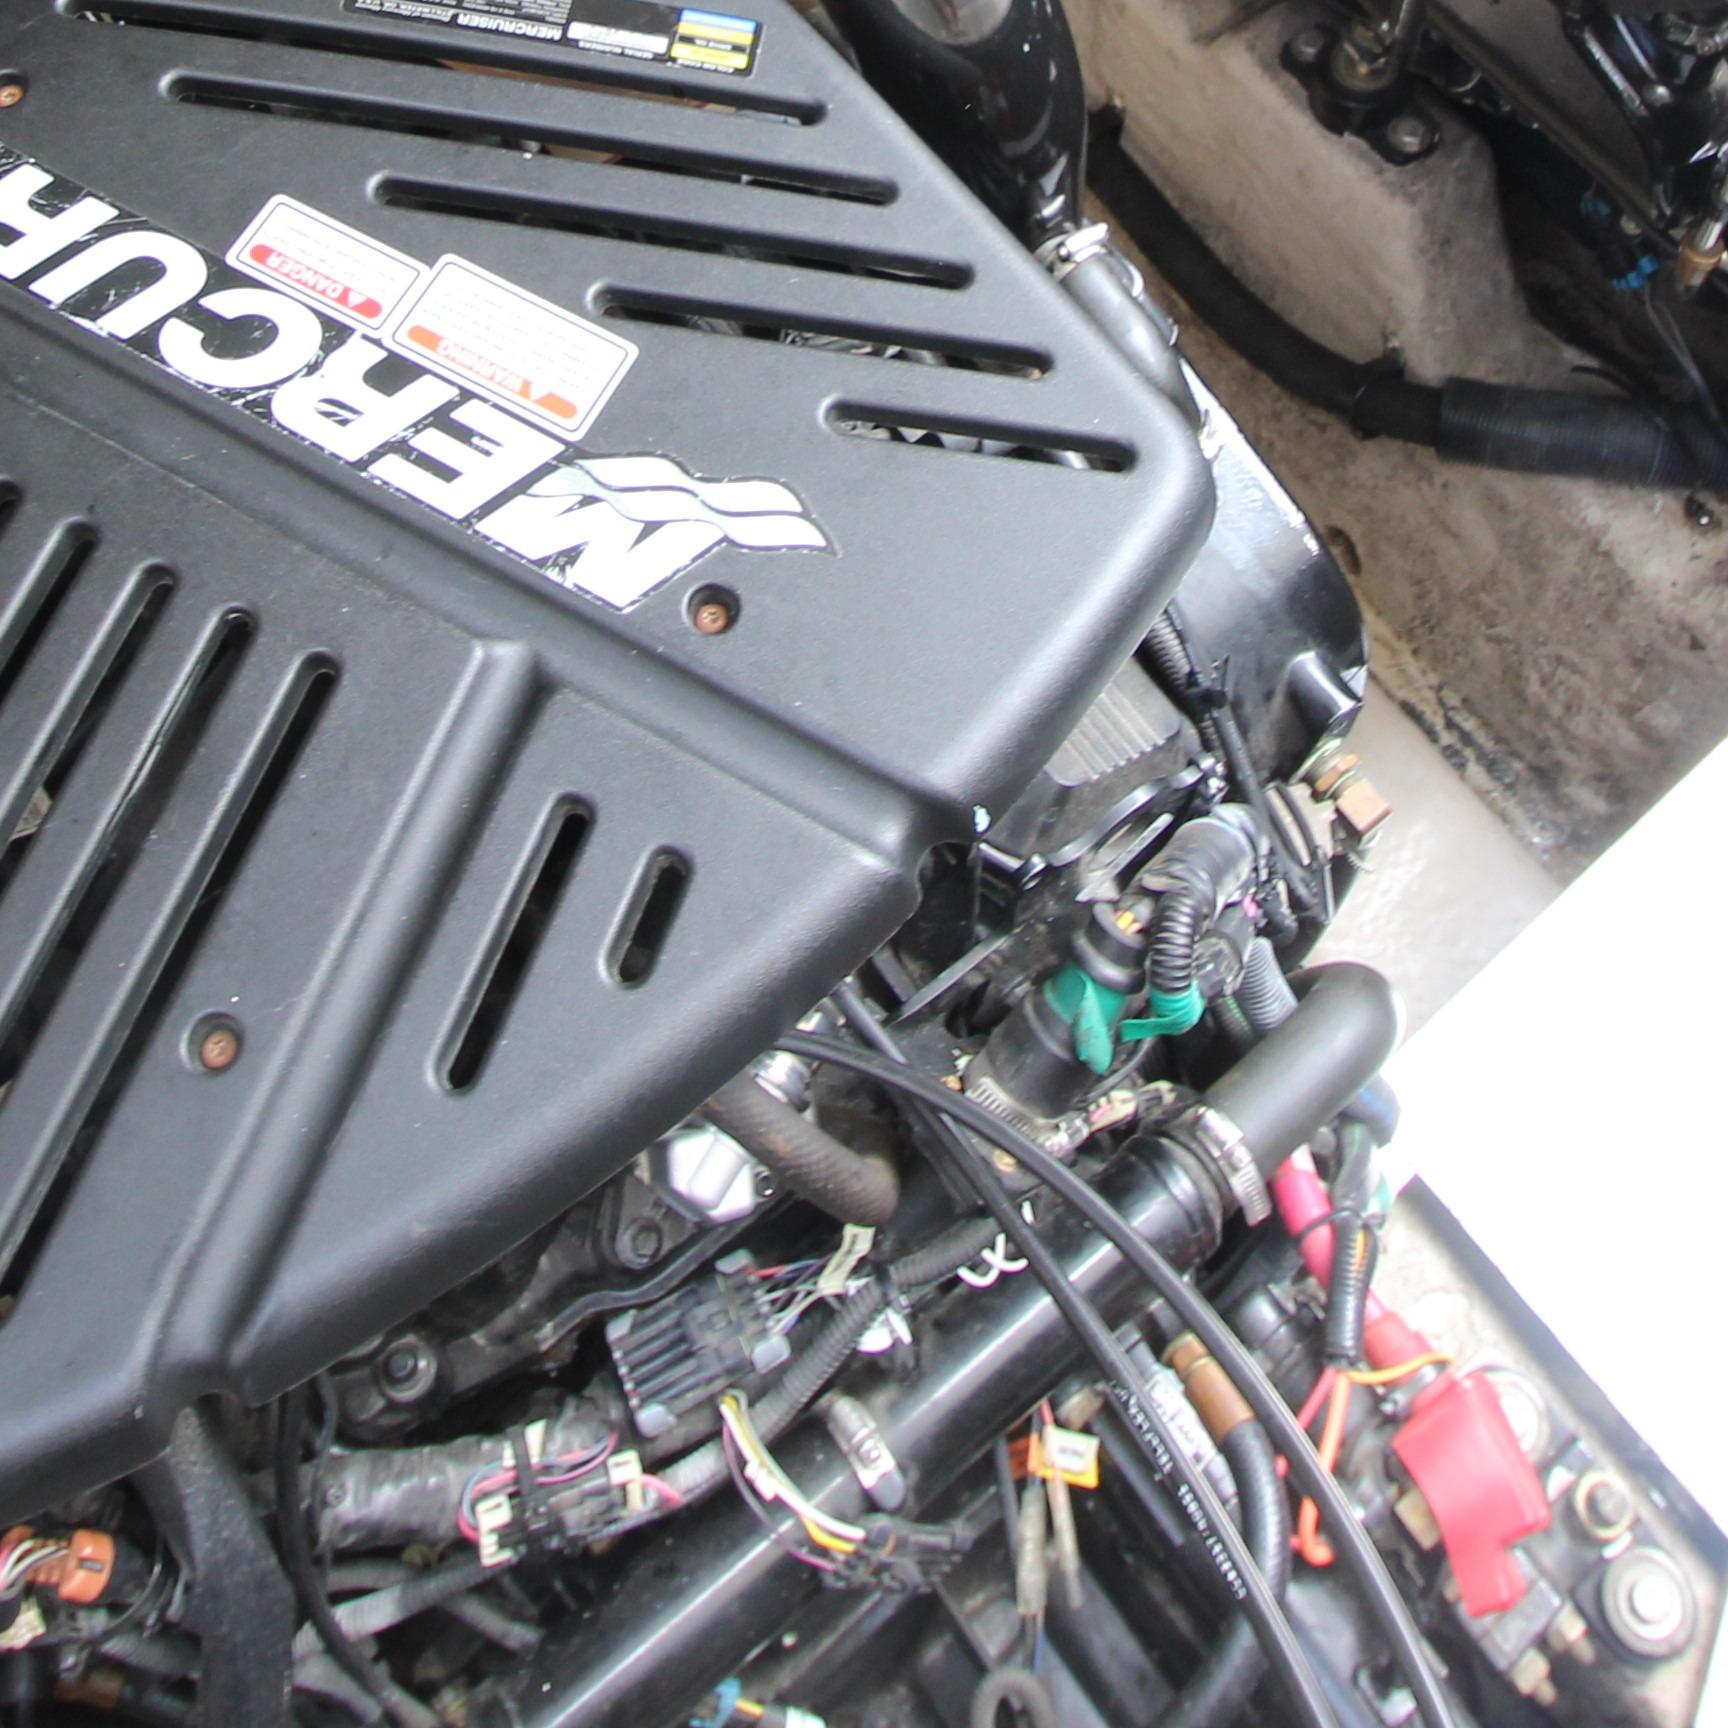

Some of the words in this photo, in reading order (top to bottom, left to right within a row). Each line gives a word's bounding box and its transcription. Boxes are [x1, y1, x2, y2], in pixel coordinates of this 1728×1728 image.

[458, 14, 562, 41] MERCRUISER
[267, 251, 344, 299] DANGER
[436, 337, 524, 393] WARNING
